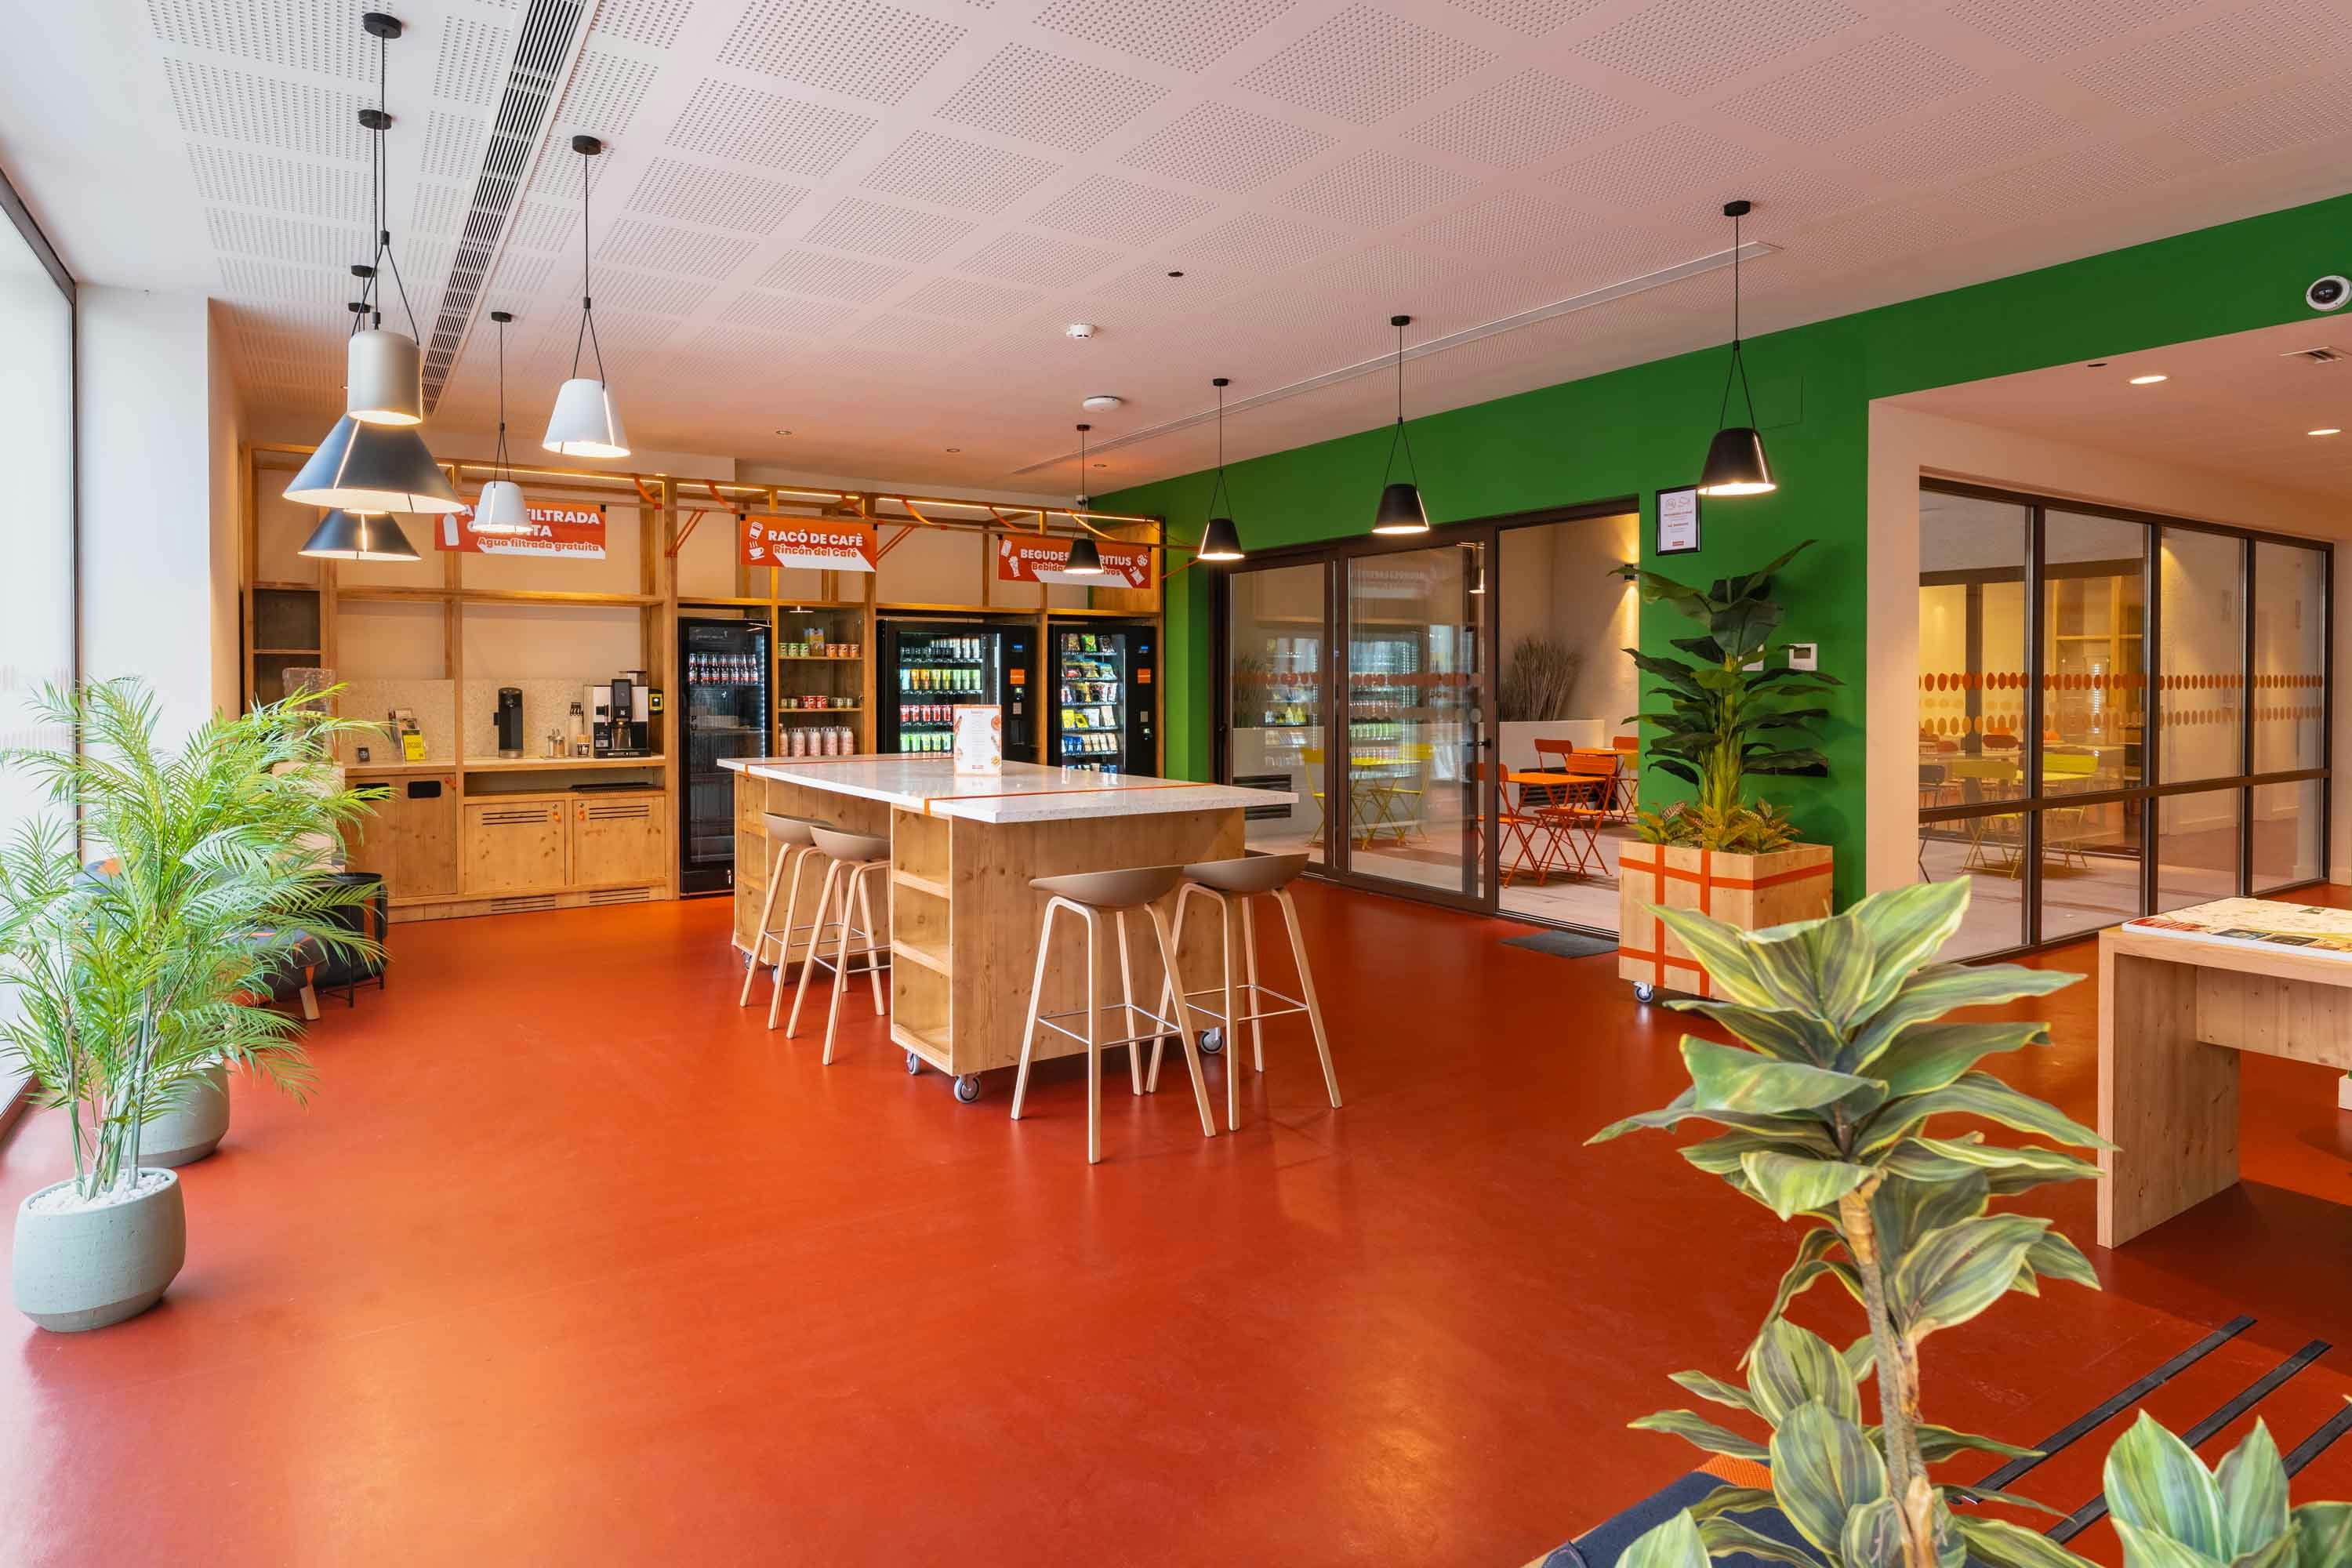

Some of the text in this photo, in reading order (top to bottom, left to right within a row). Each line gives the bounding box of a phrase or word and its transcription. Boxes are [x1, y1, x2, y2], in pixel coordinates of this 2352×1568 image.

[768, 529, 808, 543] RACÓ
[810, 532, 828, 545] DE
[478, 538, 599, 551] Agua filtrada gratuita
[774, 544, 858, 558] Rincón del Café
[1098, 554, 1132, 566] RITIUS
[1033, 562, 1066, 572] Bebida
